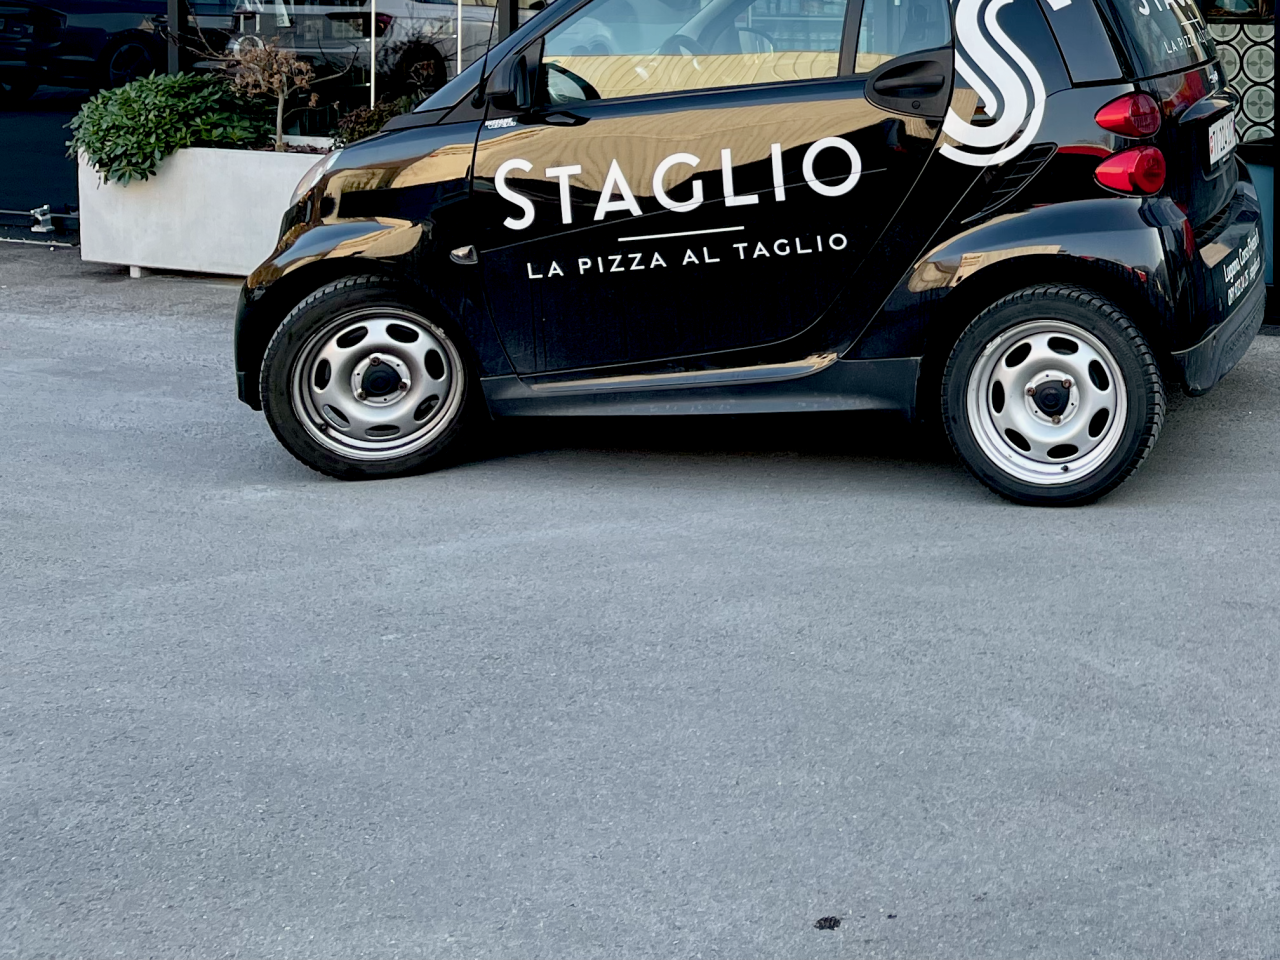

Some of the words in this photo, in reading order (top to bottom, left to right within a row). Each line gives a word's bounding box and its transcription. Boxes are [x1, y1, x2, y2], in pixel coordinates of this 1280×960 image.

[494, 136, 862, 231] STAGLIO
[527, 261, 564, 279] LA
[578, 251, 667, 276] PIZZA
[682, 246, 720, 266] AL
[733, 233, 848, 260] TAGLIO
